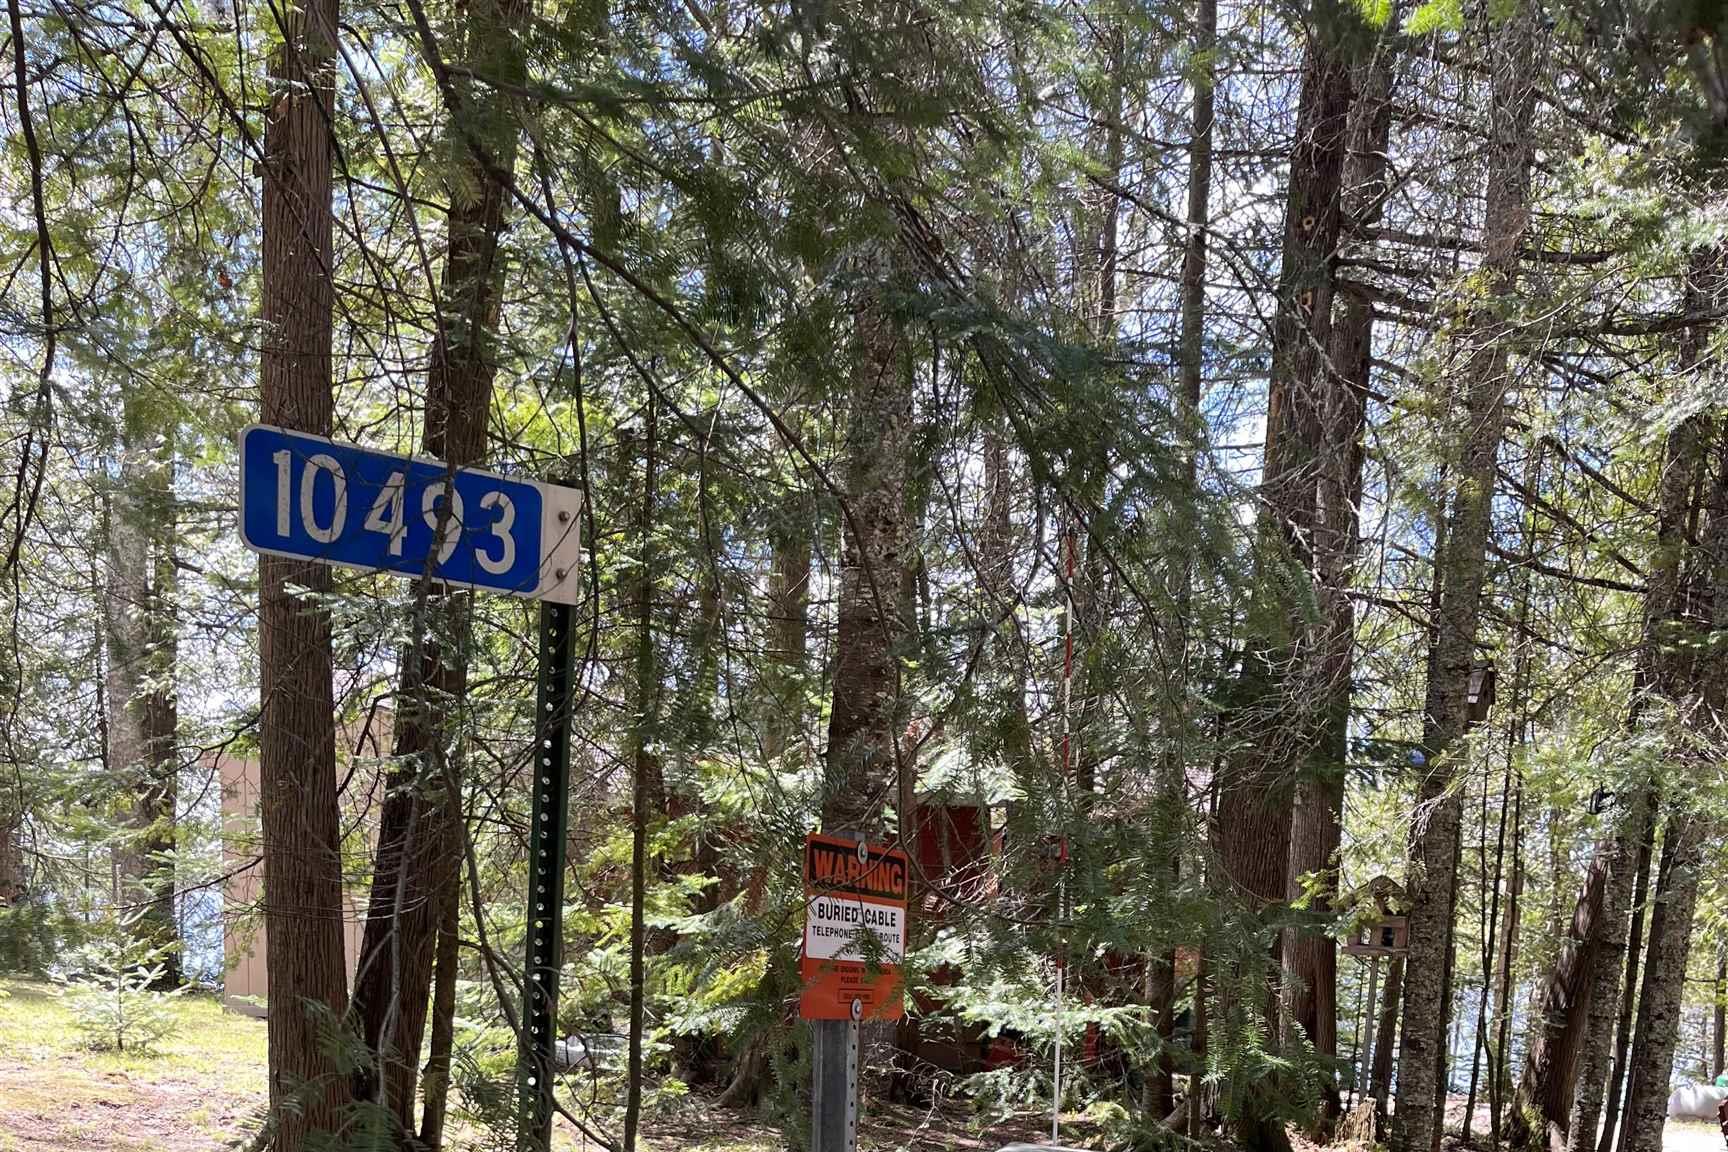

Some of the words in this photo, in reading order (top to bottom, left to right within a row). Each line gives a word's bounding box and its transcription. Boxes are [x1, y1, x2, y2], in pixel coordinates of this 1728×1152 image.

[273, 449, 517, 575] 10493
[814, 850, 902, 893] WARNING
[818, 903, 858, 922] BURIED
[865, 909, 896, 927] CABLE
[812, 925, 853, 939] TELEPHONE
[880, 932, 899, 944] ROUTE
